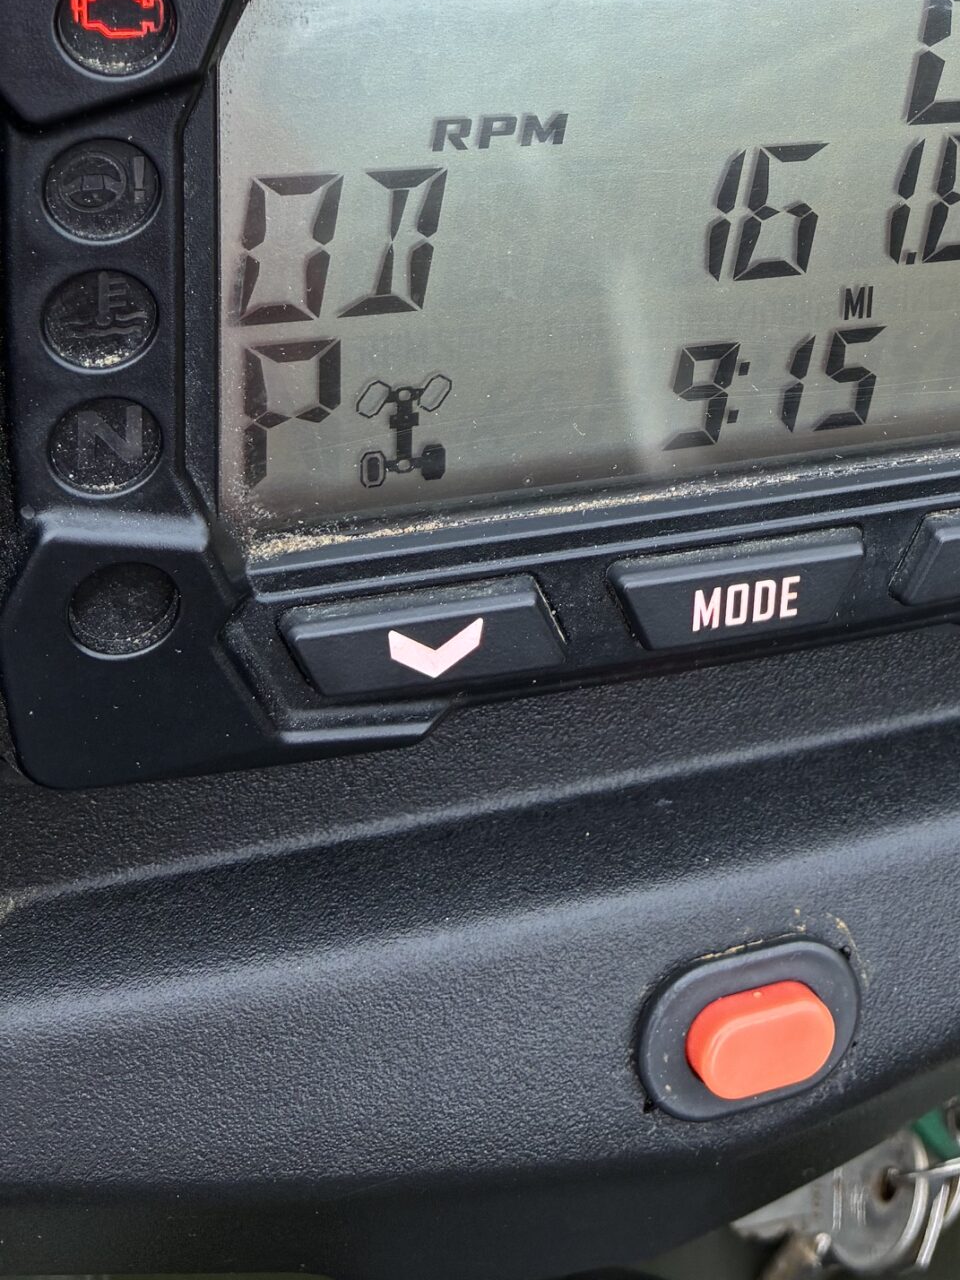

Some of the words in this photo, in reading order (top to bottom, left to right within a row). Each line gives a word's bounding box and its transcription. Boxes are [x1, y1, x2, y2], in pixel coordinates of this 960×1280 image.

[431, 113, 569, 152] RPM
[843, 285, 874, 320] MI
[244, 337, 341, 490] P
[662, 326, 888, 451] 9:15
[692, 575, 801, 632] MODE
